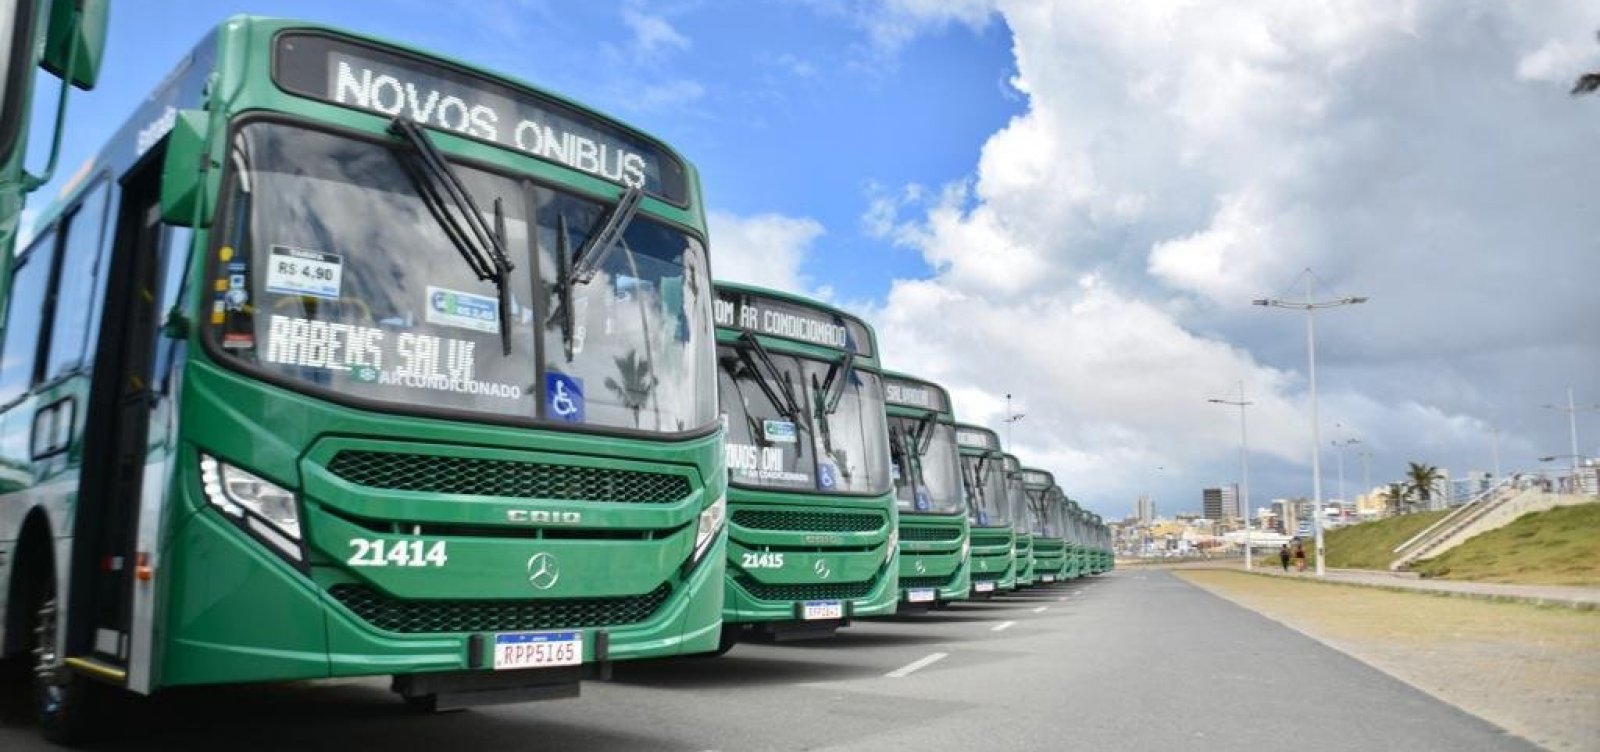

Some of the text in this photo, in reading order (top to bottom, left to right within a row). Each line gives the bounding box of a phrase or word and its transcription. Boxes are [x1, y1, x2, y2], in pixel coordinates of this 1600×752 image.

[335, 61, 646, 188] NOVOS ONIBUS
[714, 299, 846, 347] OM AR CONDICIONADO
[378, 370, 521, 399] AR CONDICIONADO
[507, 509, 581, 523] CAIO
[347, 538, 448, 567] 21414
[741, 552, 784, 569] 21415
